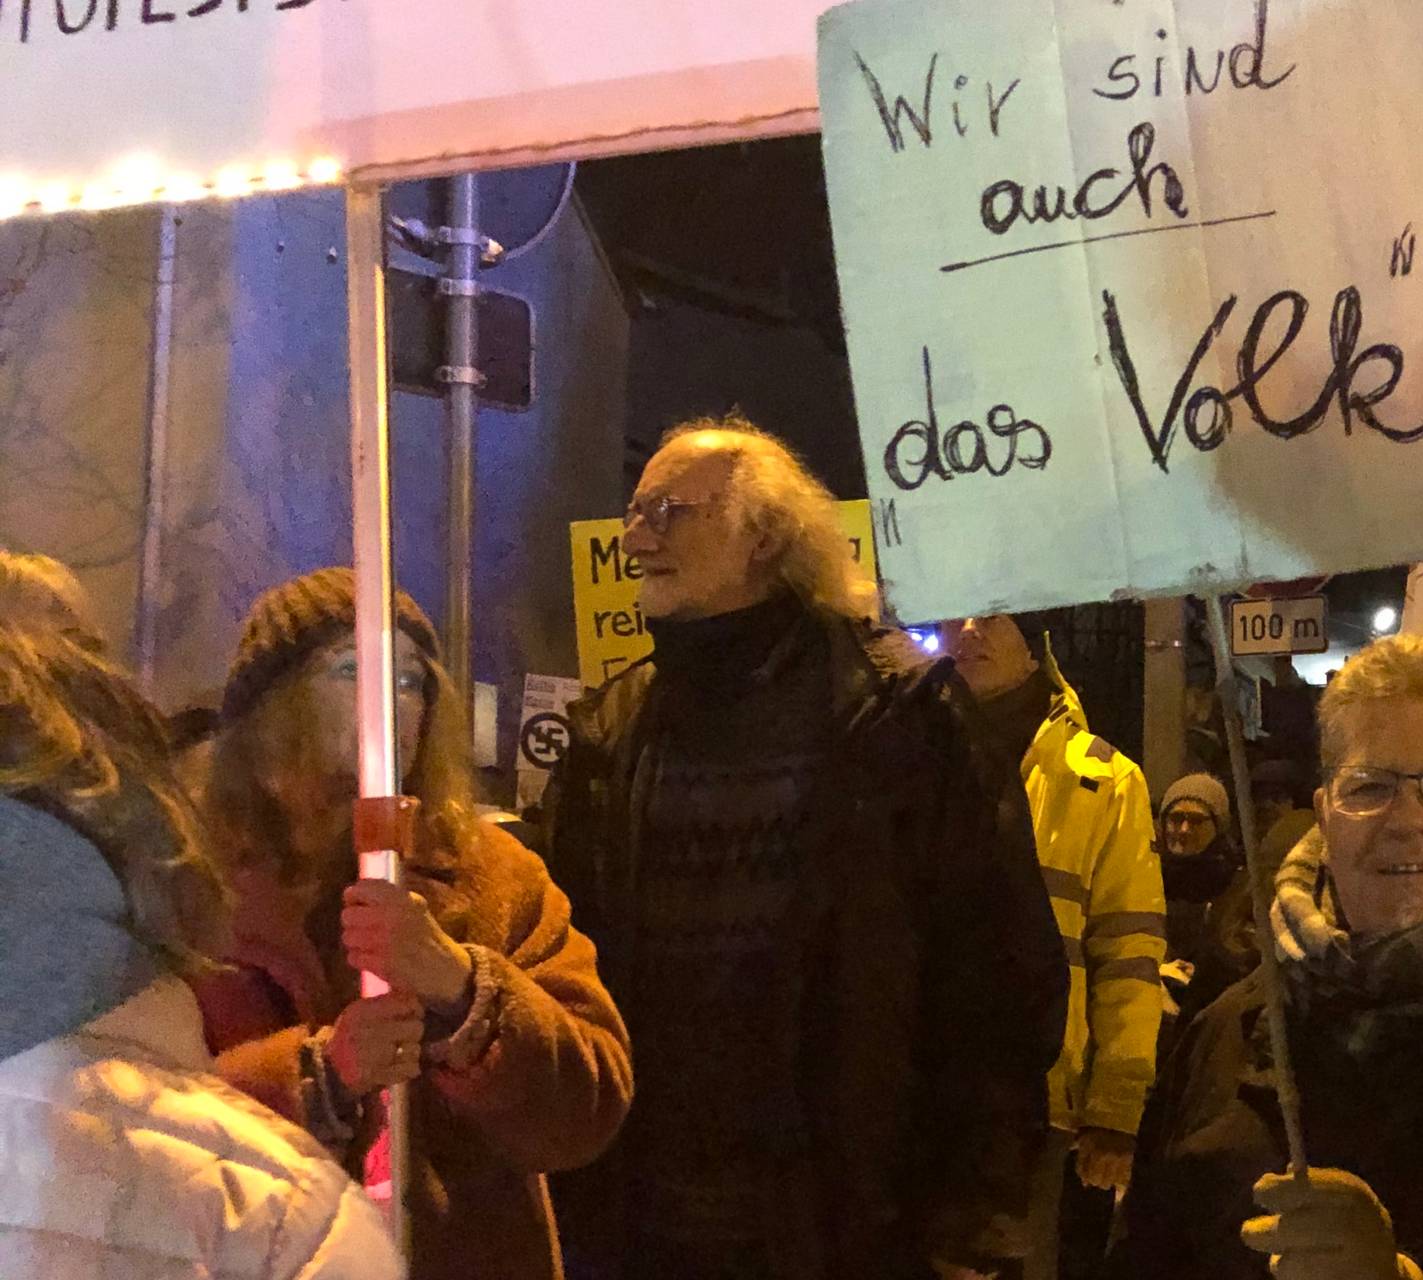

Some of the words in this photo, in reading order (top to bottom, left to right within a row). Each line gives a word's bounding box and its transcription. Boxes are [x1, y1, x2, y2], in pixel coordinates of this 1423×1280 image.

[853, 49, 1021, 153] Wir
[1093, 0, 1297, 99] sind
[980, 120, 1189, 236] auch
[590, 536, 644, 584] Me
[594, 602, 655, 639] rei
[1240, 613, 1283, 642] 100
[1293, 618, 1319, 637] m
